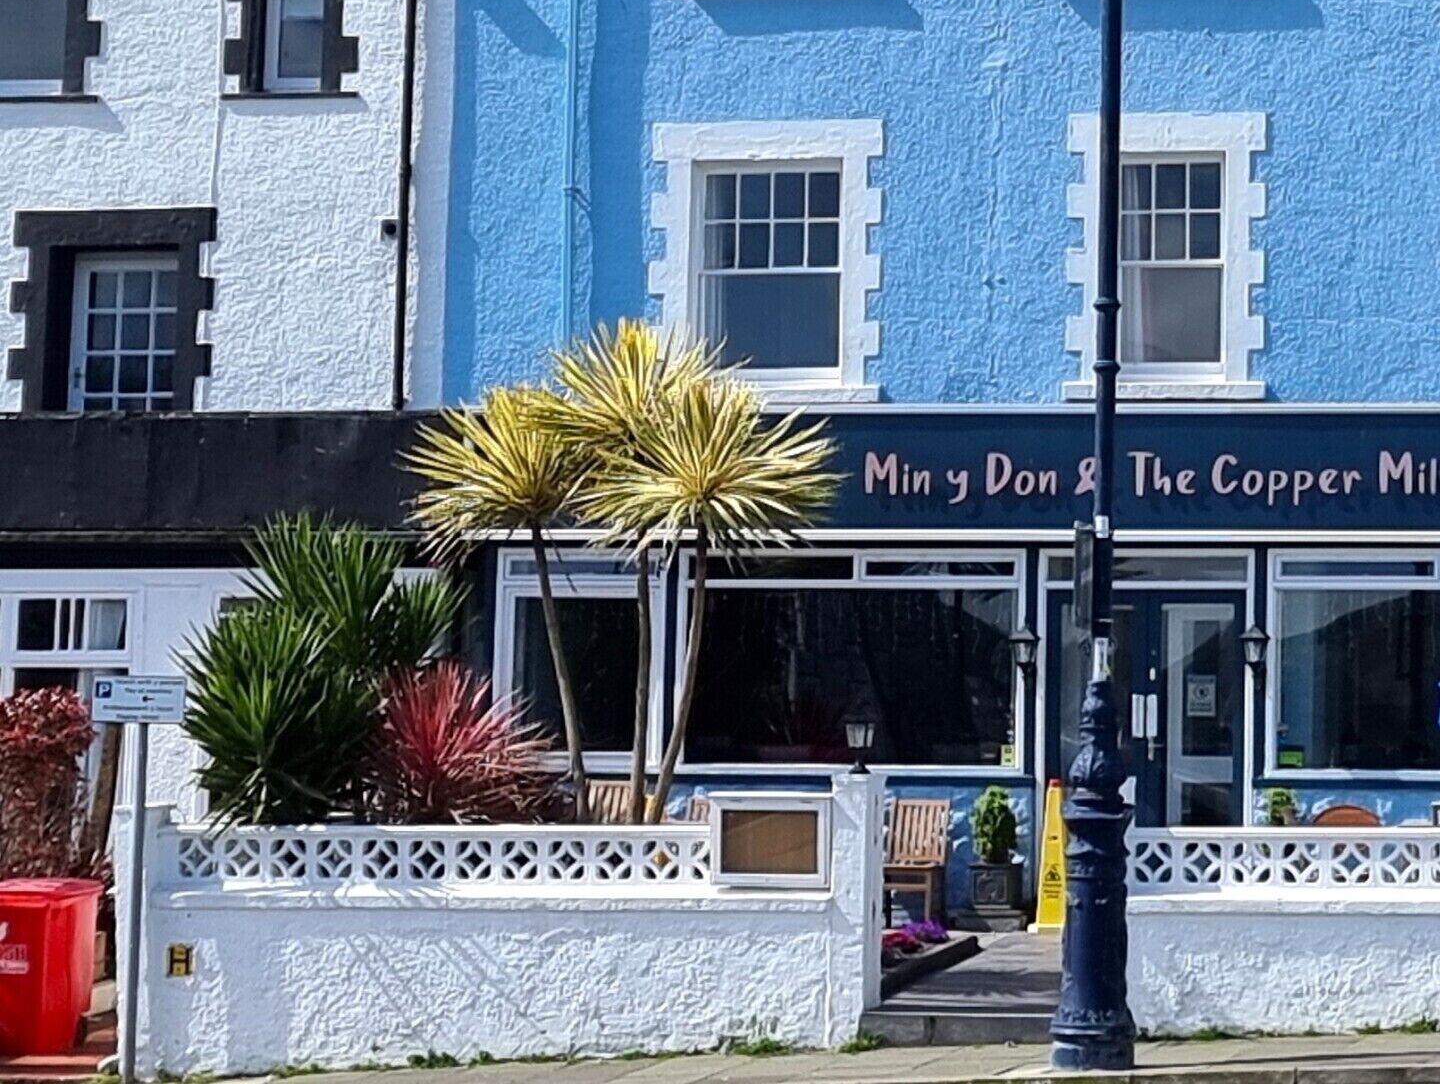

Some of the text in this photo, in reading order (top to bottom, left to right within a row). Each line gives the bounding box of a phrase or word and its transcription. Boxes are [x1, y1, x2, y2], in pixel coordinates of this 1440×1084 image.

[864, 451, 931, 496] Min
[945, 469, 969, 504] y
[985, 452, 1058, 496] Don
[1074, 456, 1097, 495] &
[1127, 451, 1196, 497] The
[1210, 453, 1362, 506] Copper
[98, 683, 111, 698] P
[168, 946, 192, 976] H
